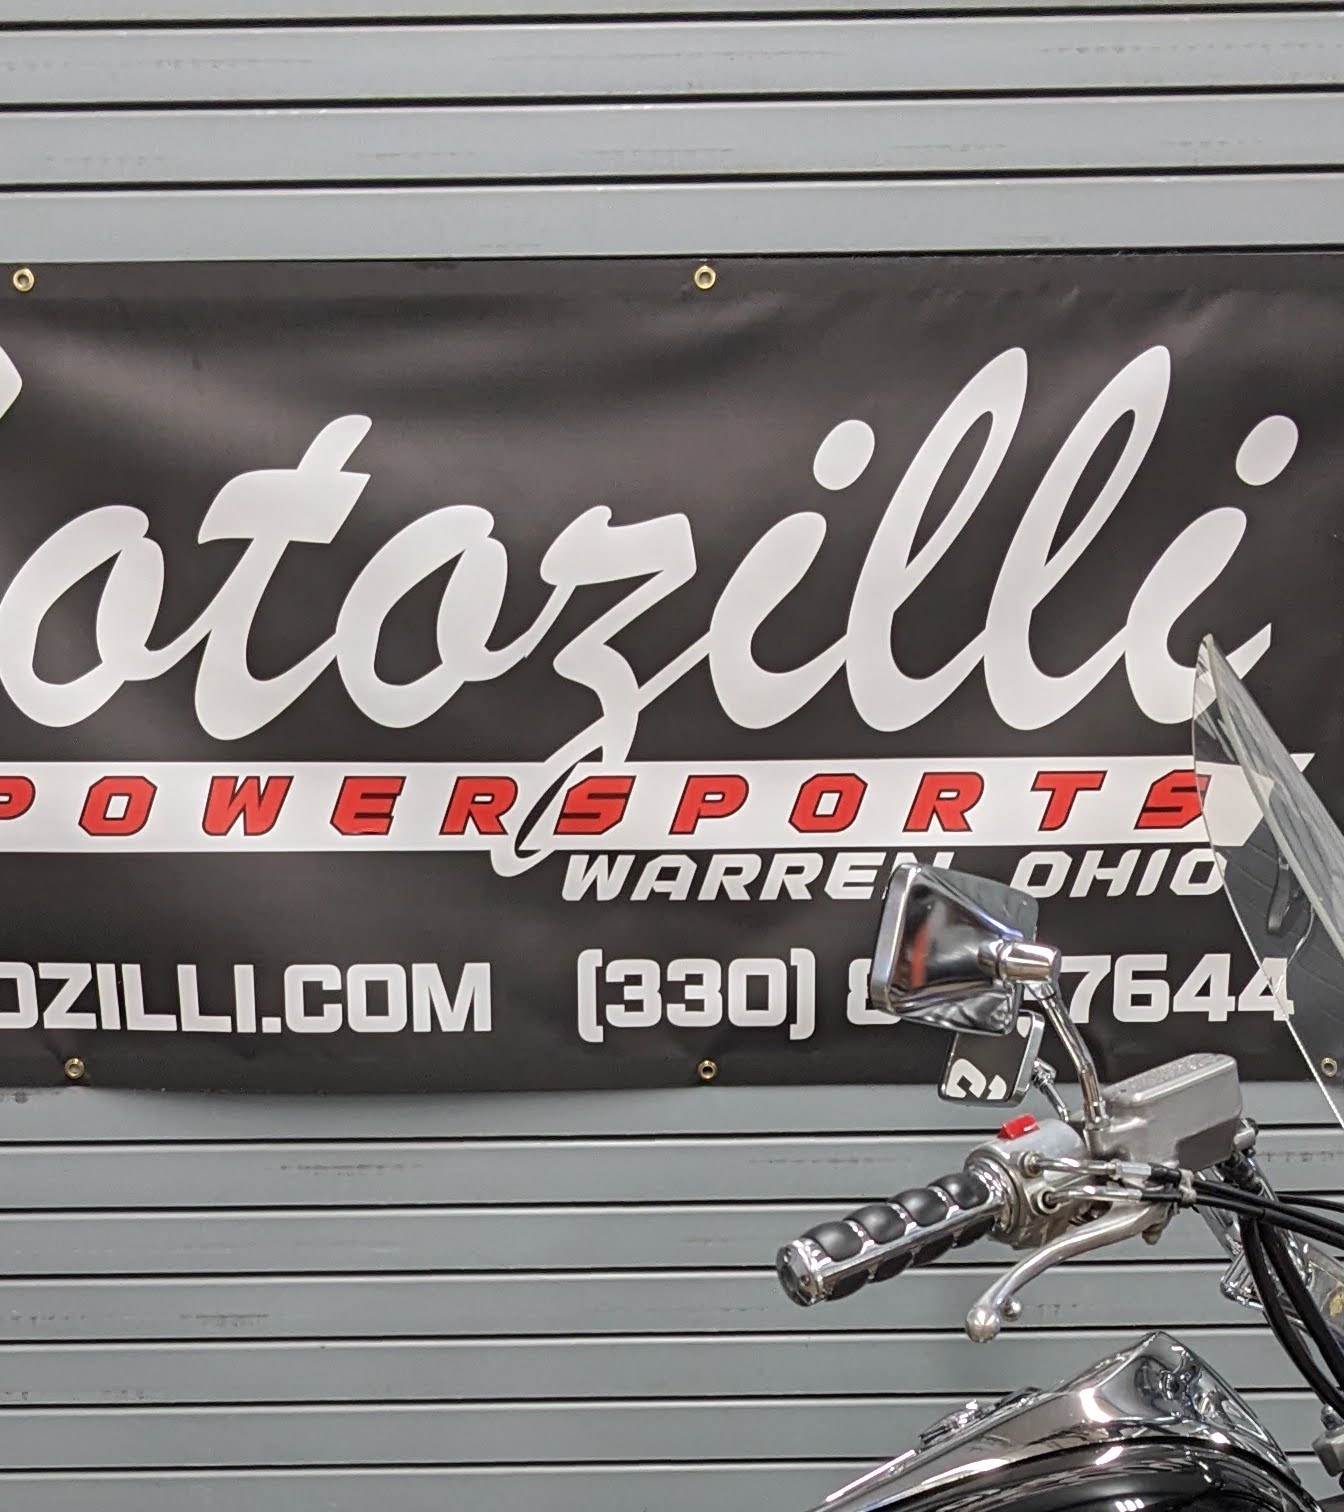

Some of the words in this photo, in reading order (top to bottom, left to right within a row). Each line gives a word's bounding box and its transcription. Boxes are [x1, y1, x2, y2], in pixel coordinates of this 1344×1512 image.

[562, 849, 954, 904] WARRE
[1009, 848, 1228, 899] OHIO
[576, 948, 816, 1043] (330)
